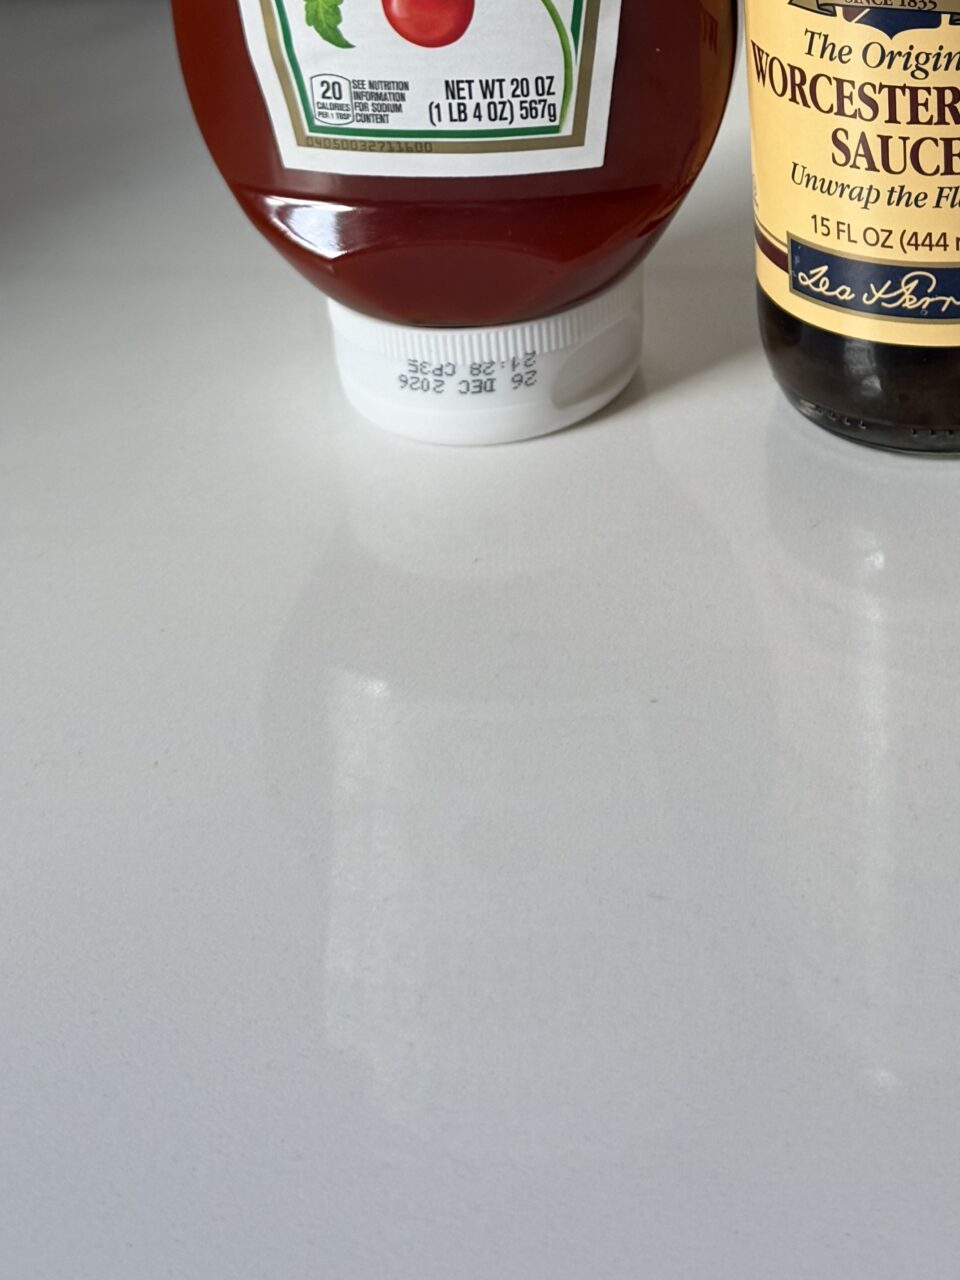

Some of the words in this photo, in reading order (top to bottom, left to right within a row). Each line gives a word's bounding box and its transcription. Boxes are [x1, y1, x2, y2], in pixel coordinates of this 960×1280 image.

[804, 28, 852, 65] The
[321, 80, 342, 100] 20
[352, 80, 366, 90] SEE
[368, 81, 409, 91] NUTRITION
[445, 80, 474, 100] NET
[479, 78, 507, 99] WT
[510, 78, 530, 98] 20
[535, 76, 556, 97] OZ
[317, 101, 351, 111] CALORIES
[353, 91, 406, 102] INFORMATION
[354, 102, 369, 112] FOR
[371, 102, 403, 113] SODIUM
[428, 101, 442, 126] (1
[449, 102, 468, 123] LB
[473, 102, 482, 122] 4
[487, 100, 514, 125] OZ)
[519, 99, 557, 123] 567g
[355, 114, 389, 124] CONTENT
[791, 162, 880, 209] Unwrap
[886, 184, 928, 208] the
[810, 214, 832, 236] 15
[836, 223, 858, 244] FL
[864, 228, 894, 249] OZ
[899, 228, 950, 254] (444
[798, 265, 855, 301] Lea
[398, 373, 445, 394] 2026
[458, 377, 497, 394] DEC
[511, 370, 538, 390] 26
